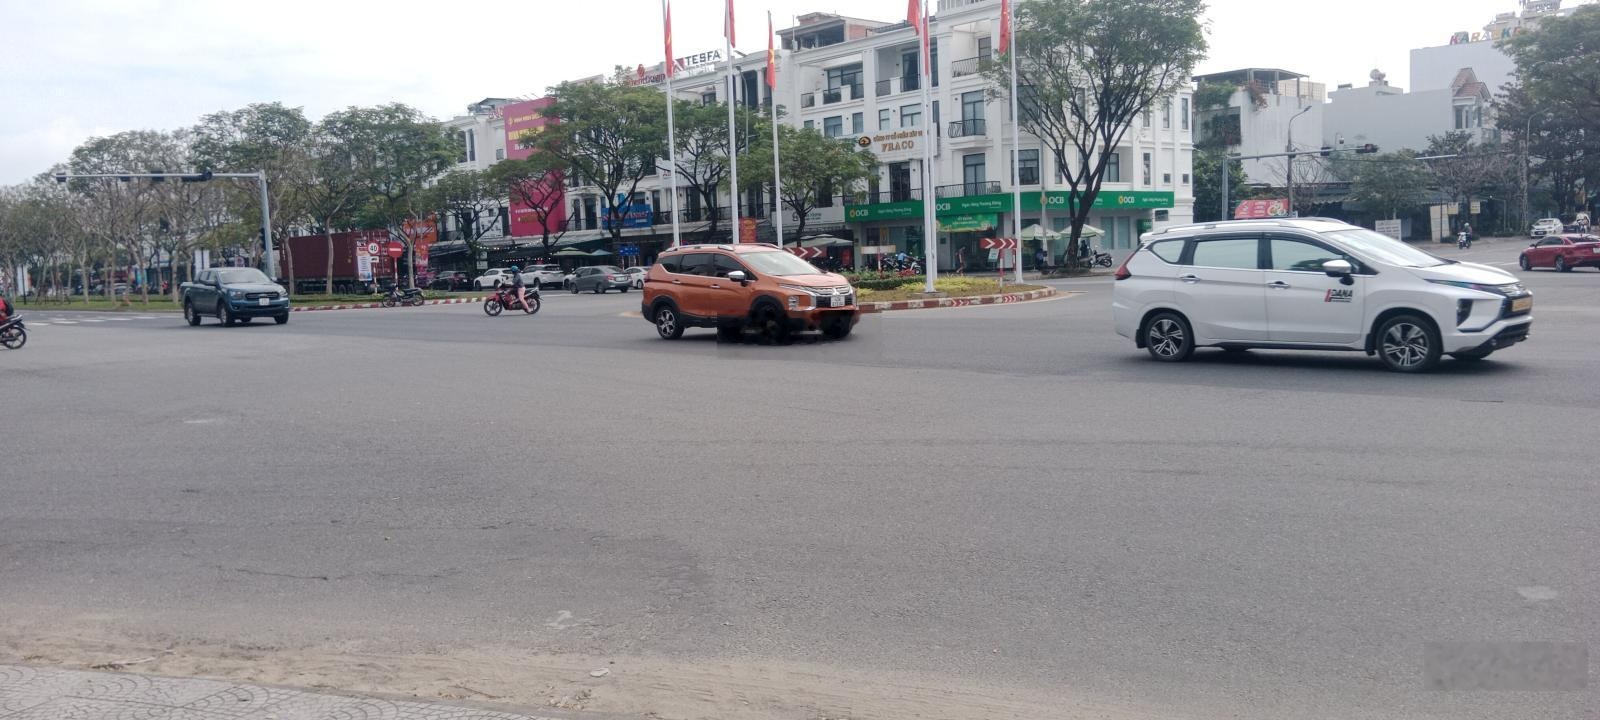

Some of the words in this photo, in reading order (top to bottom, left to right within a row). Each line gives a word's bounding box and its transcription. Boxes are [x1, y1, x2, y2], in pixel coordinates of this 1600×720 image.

[685, 50, 721, 67] TESFA
[1048, 196, 1064, 204] OCB
[1123, 196, 1135, 204] OCB
[936, 203, 951, 211] OCB
[855, 209, 869, 217] OCB
